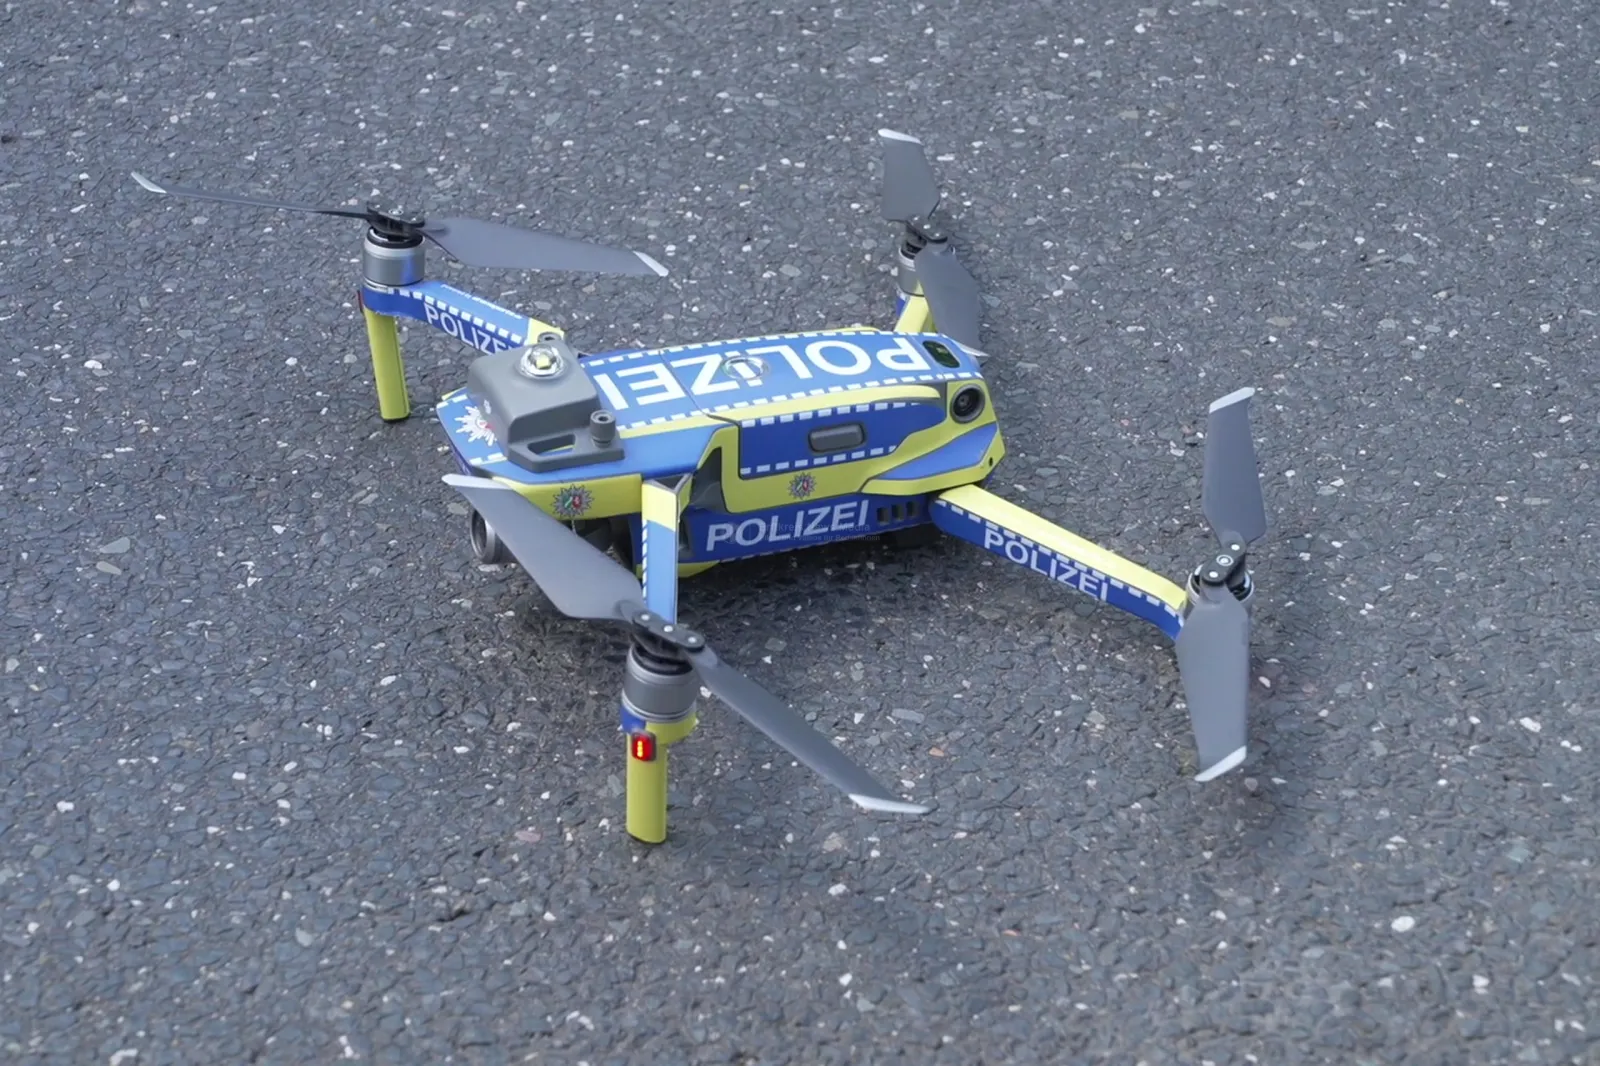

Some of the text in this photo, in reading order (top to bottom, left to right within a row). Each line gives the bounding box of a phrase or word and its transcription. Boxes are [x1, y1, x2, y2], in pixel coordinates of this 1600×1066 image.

[423, 302, 513, 355] POLIZE
[593, 337, 932, 411] POLIZEI
[706, 499, 869, 552] POLIZEI
[984, 525, 1108, 602] POLIZEI
